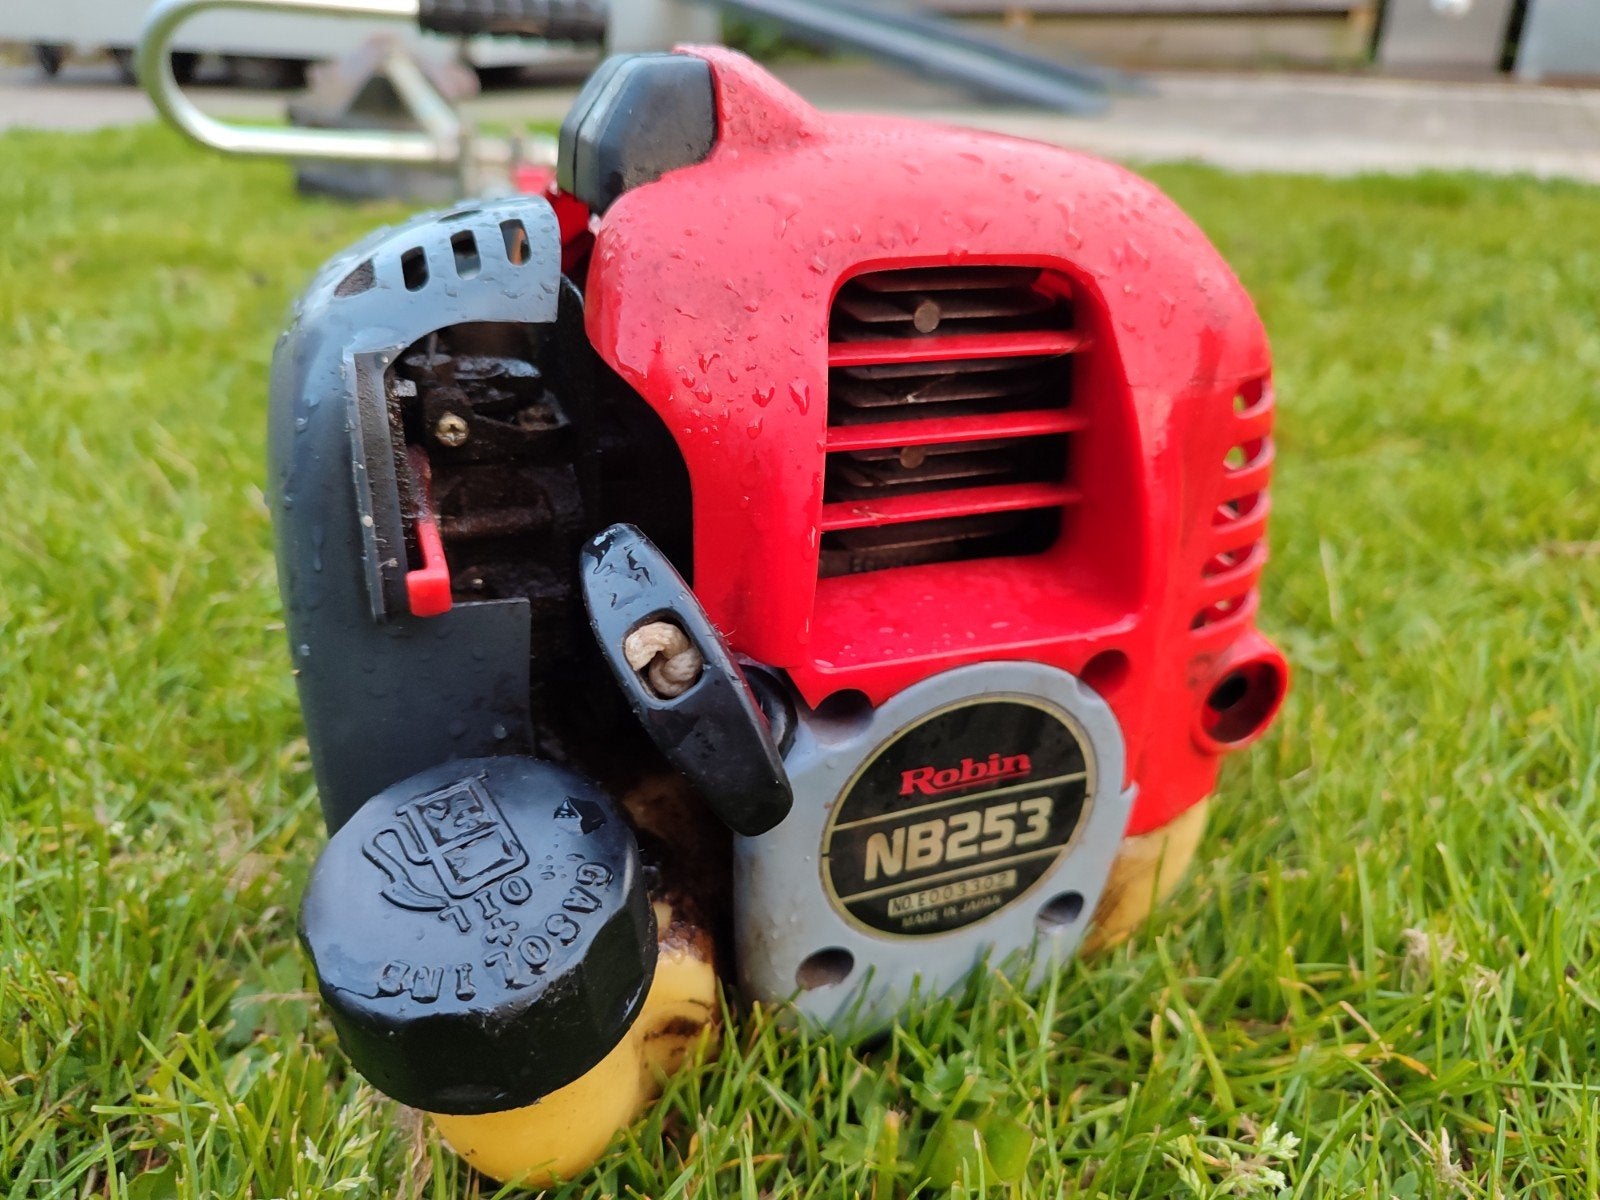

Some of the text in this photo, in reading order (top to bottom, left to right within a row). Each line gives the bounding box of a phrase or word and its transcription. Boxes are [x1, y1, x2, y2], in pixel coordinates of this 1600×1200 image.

[898, 752, 1032, 796] Robin
[864, 796, 1053, 882] NB253
[438, 875, 533, 934] OIL
[901, 893, 1003, 929] MADE IN JAPAN
